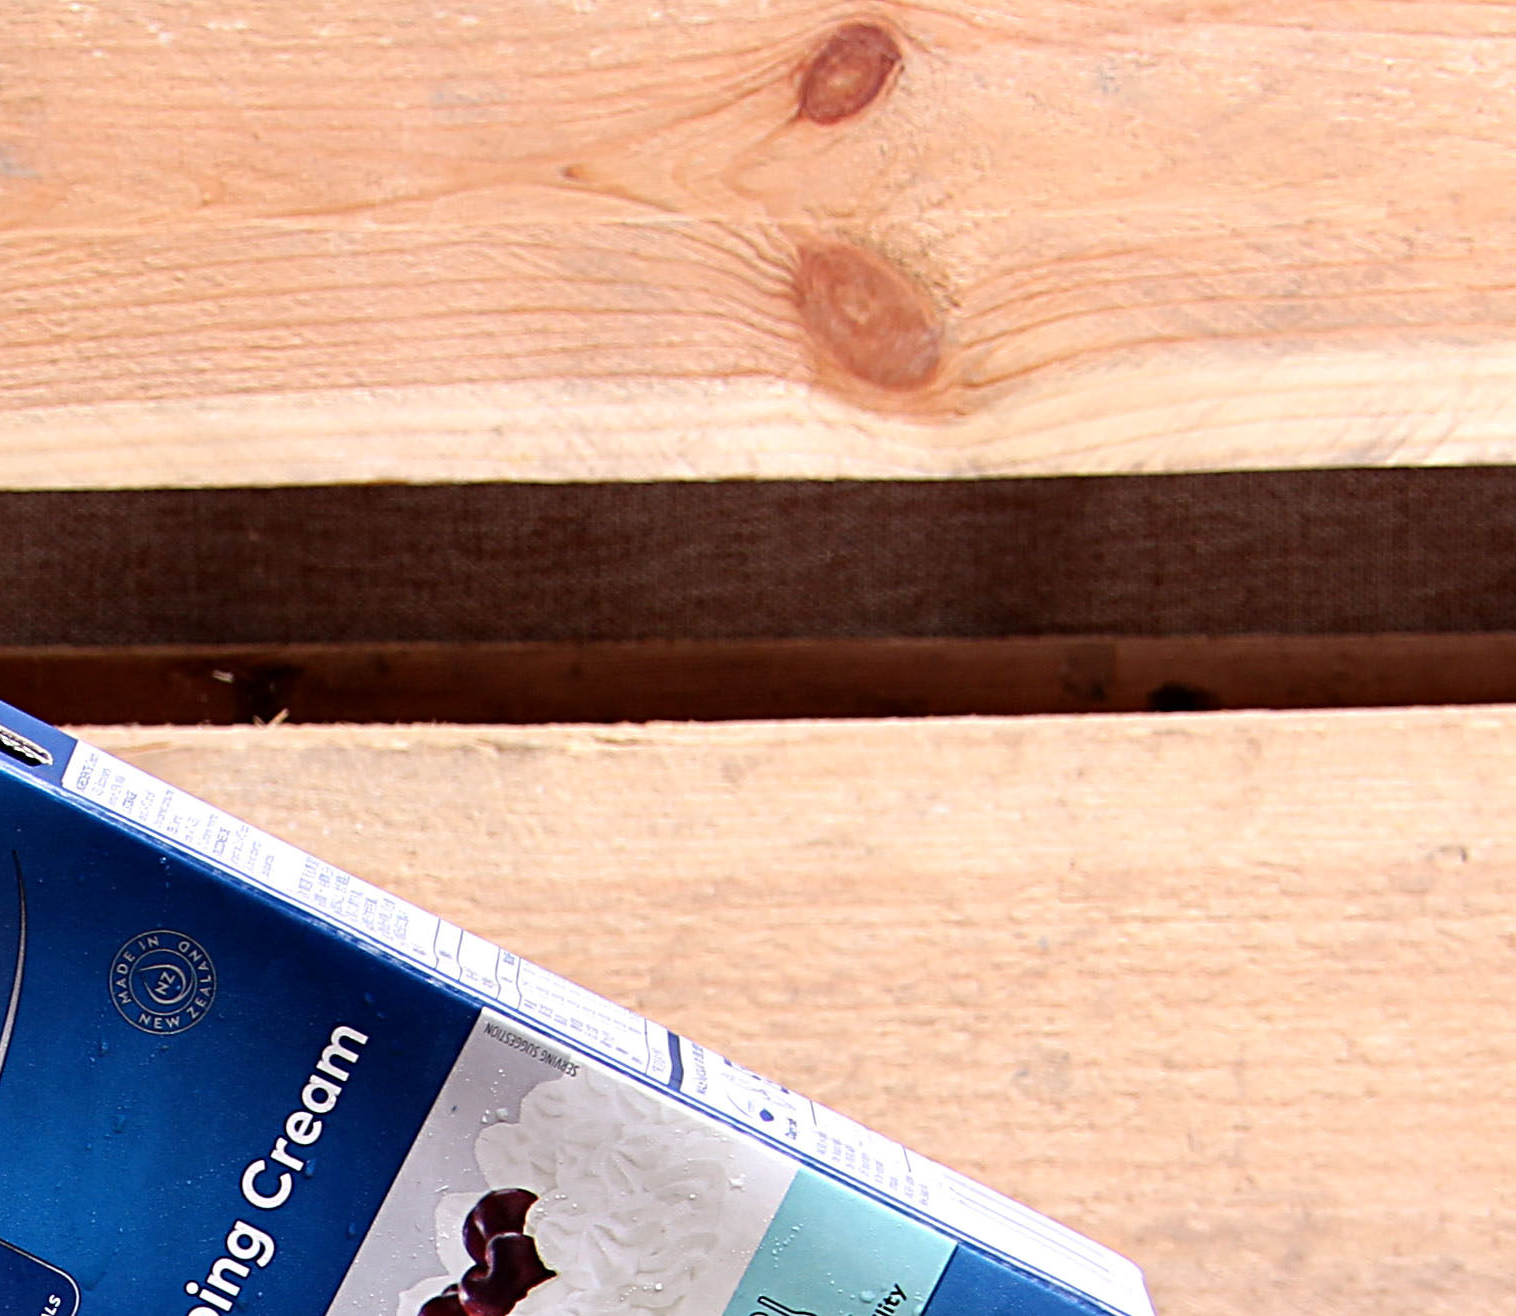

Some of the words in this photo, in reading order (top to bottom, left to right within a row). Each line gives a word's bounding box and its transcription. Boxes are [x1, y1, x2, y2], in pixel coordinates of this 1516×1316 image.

[119, 943, 144, 1005] MADE
[139, 935, 160, 951] IN
[139, 1013, 181, 1030] NEW
[177, 939, 212, 1019] ZEALAND
[485, 1022, 540, 1058] SUGGESTION
[540, 1050, 580, 1077] SERVING
[241, 1025, 369, 1210] Cream
